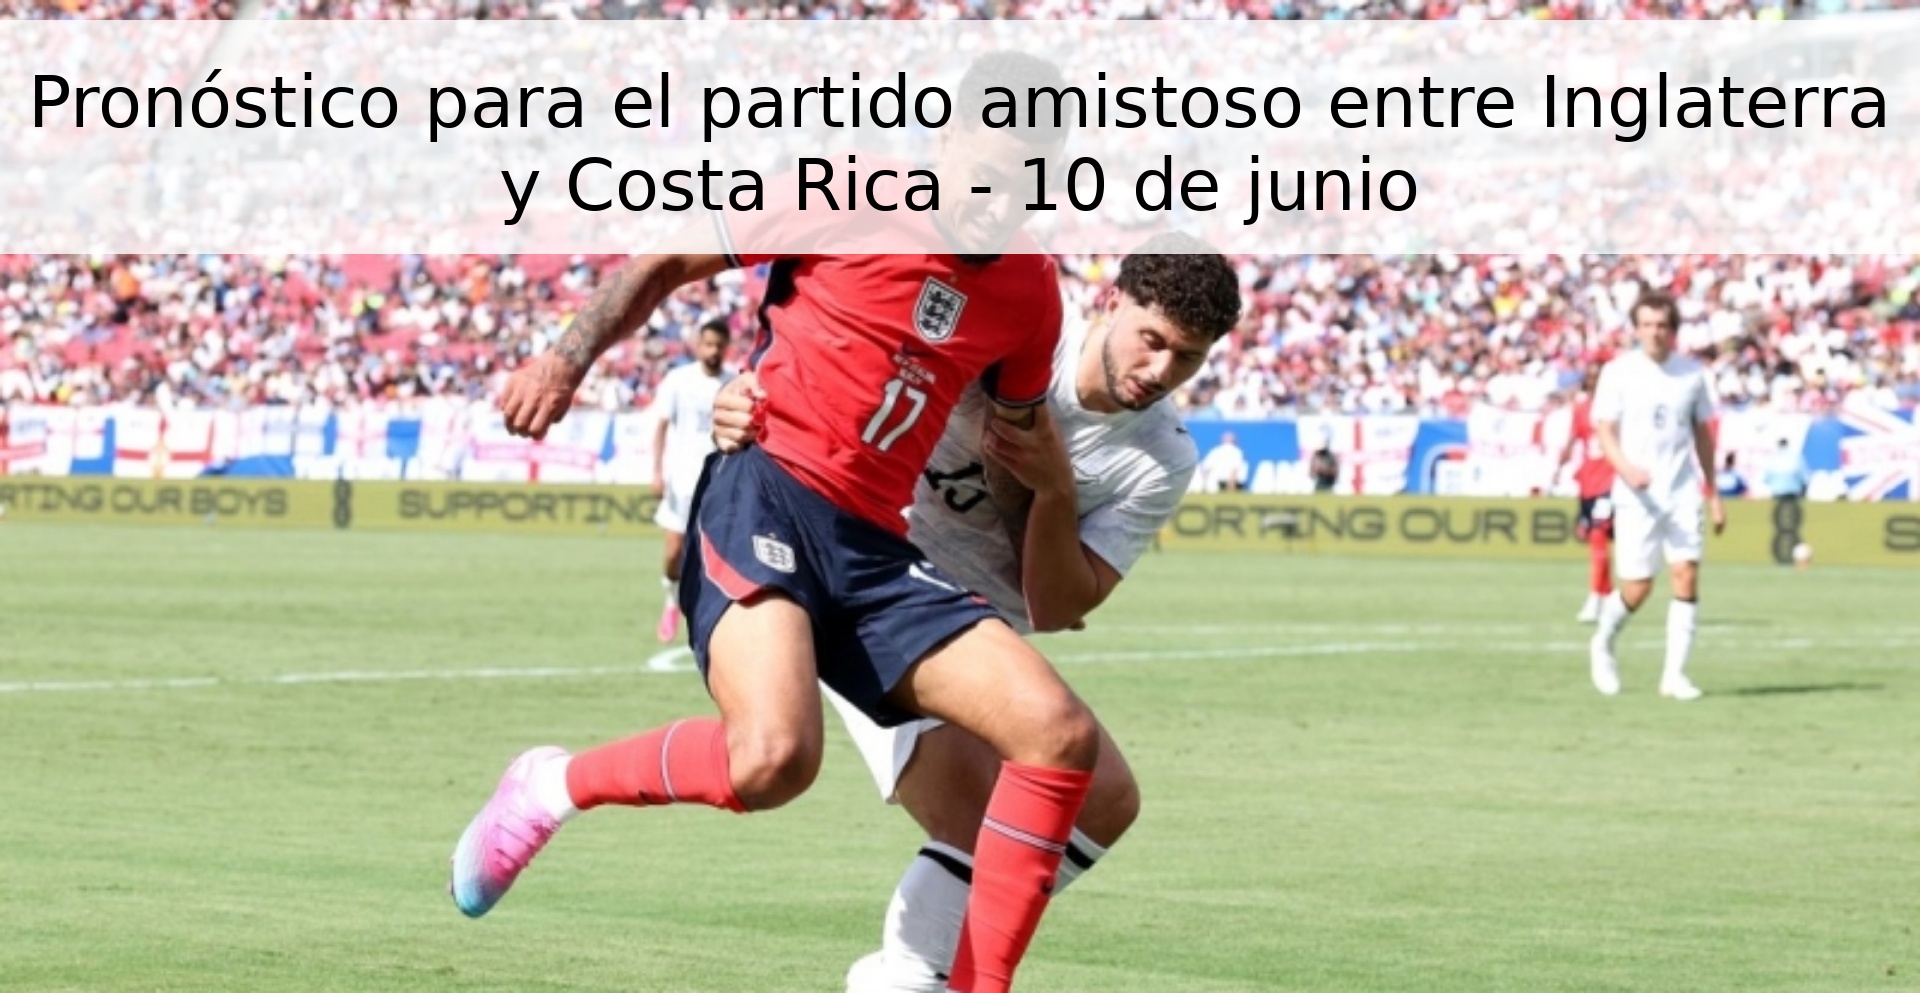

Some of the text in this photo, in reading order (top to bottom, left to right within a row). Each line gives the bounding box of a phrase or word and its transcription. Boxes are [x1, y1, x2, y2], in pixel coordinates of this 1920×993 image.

[860, 378, 928, 452] 17
[111, 485, 184, 513] OUR
[190, 487, 288, 516] BOYS
[398, 489, 661, 524] SUPPORTING
[1401, 508, 1519, 543] OUR
